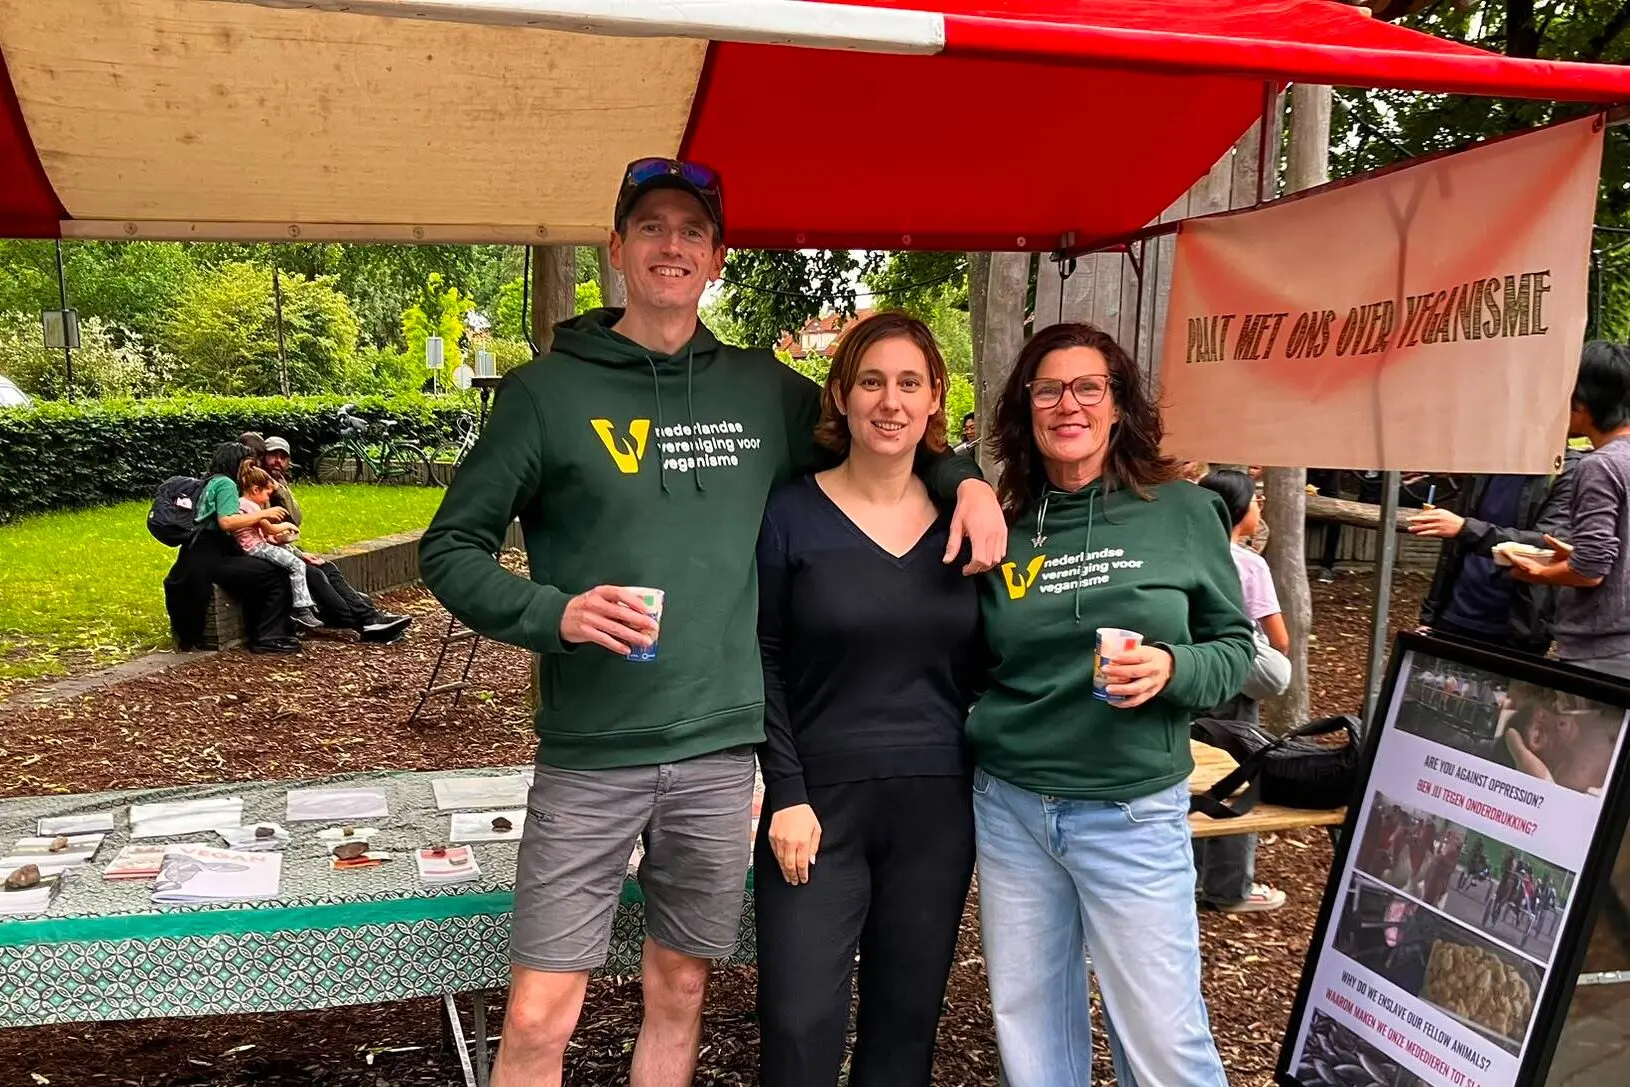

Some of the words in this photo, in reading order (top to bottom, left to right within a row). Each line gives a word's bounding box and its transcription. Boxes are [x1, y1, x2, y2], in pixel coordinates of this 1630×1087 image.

[1233, 313, 1289, 361] MET
[1285, 310, 1336, 359] ONS
[1336, 300, 1394, 357] OVER
[1397, 269, 1551, 349] VEGANISME
[655, 421, 744, 438] nederlandse
[657, 437, 735, 453] vereniging
[738, 438, 761, 449] voor
[1042, 562, 1109, 580] vereniging
[1111, 559, 1144, 569] voor
[1044, 548, 1124, 568] nederlandse
[1040, 574, 1110, 593] veganisme
[1424, 755, 1440, 771] ARE
[1439, 760, 1456, 776] YOU
[1455, 766, 1489, 788] AGAINST
[1488, 778, 1545, 809] OPPRESSION?
[1416, 778, 1433, 795] BEN
[1442, 788, 1466, 808] TEGEN
[1465, 798, 1538, 837] ONDERDRUKKING?
[1326, 987, 1354, 1015] WAAROM
[1353, 1005, 1377, 1030] MAKEN
[1376, 1020, 1388, 1037] WE
[1387, 1028, 1406, 1049] ONZE
[1405, 1040, 1451, 1077] MEDEDIEREN
[1450, 1068, 1466, 1087] TOT
[1341, 970, 1357, 989] WHY
[1356, 979, 1368, 995] DO
[1367, 985, 1379, 1002] WE
[1377, 992, 1408, 1021] ENSLAVE
[1407, 1011, 1424, 1030] OUR
[1423, 1021, 1452, 1048] FELLOW
[1450, 1039, 1491, 1072] ANIMALS?
